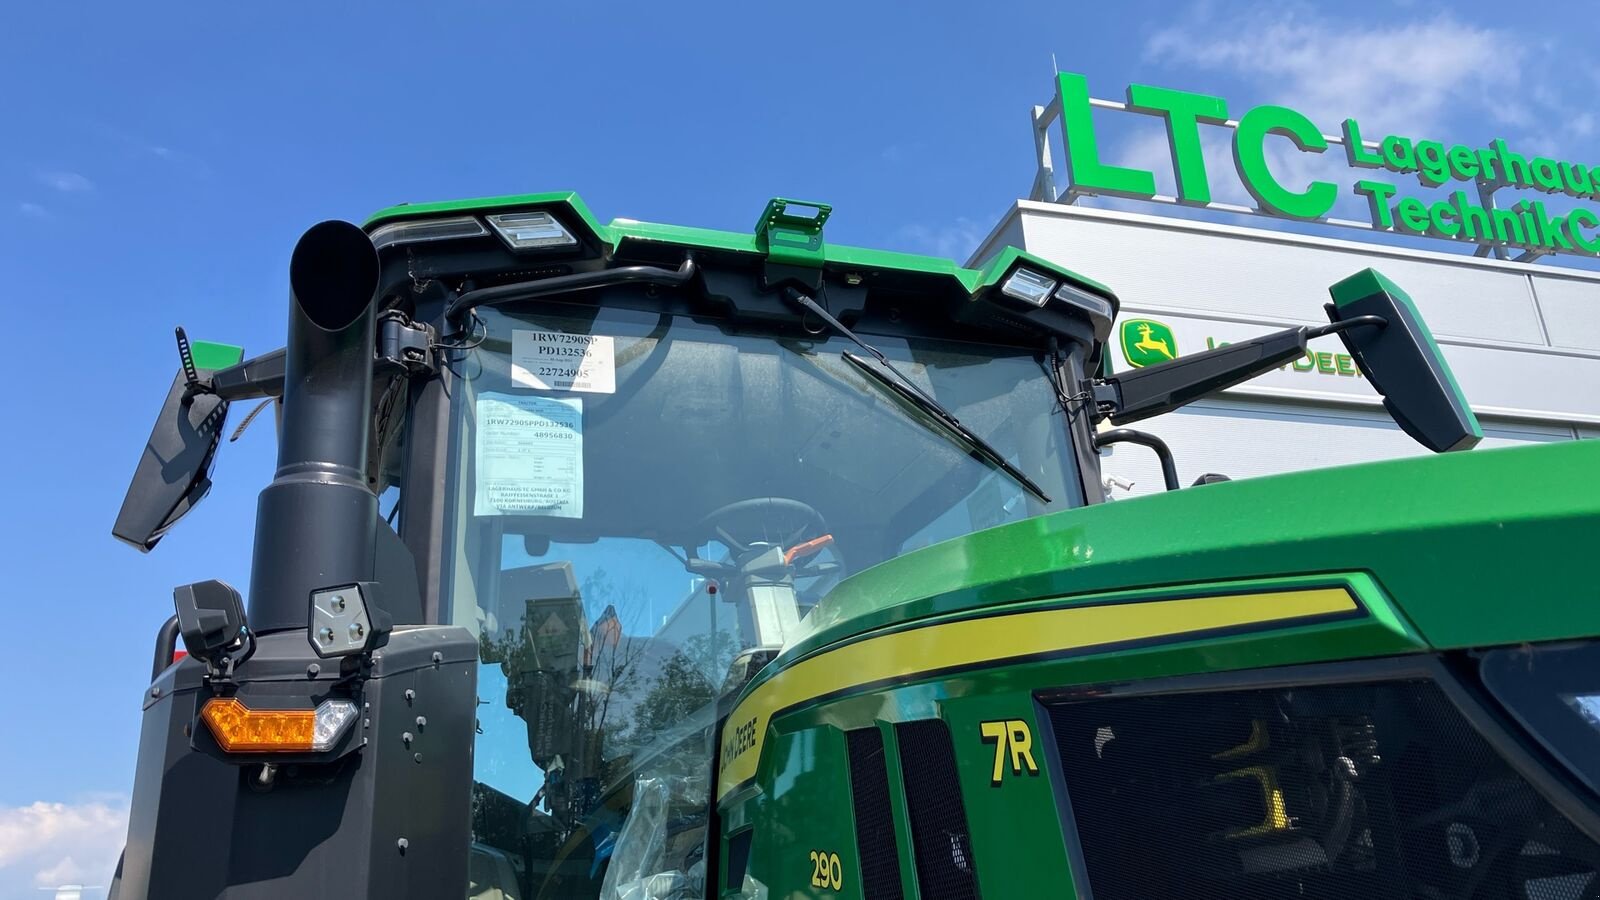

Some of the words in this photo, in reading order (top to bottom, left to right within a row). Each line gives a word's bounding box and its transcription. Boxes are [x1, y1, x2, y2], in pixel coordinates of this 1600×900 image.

[1056, 71, 1338, 219] LTC
[533, 332, 598, 345] 1RW7290SP
[539, 346, 592, 357] PD132536
[539, 367, 589, 378] 22724905
[534, 431, 573, 440] 48956830
[734, 716, 758, 760] DEERE
[980, 719, 1040, 788] 7R
[810, 850, 843, 891] 290
